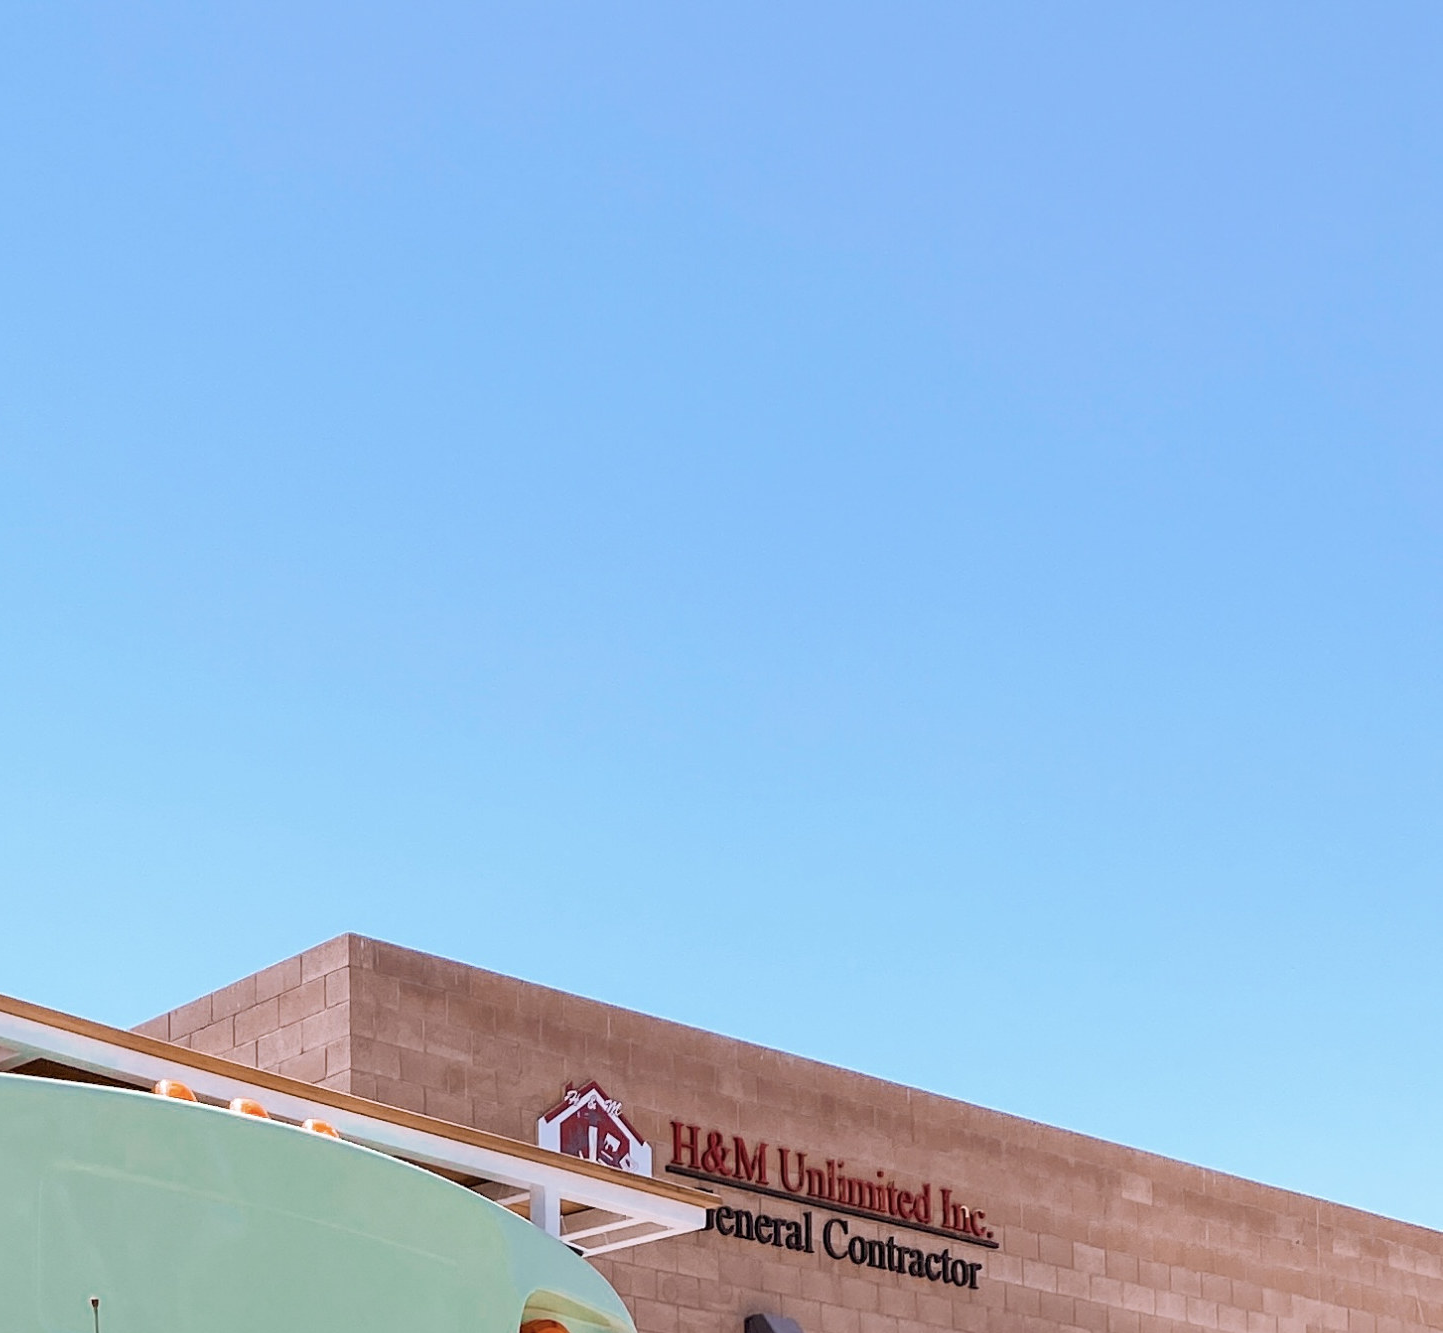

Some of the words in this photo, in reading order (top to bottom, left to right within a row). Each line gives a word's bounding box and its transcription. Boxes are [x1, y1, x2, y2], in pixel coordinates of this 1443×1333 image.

[670, 1120, 769, 1185] H&M
[777, 1147, 931, 1224] Unlimited
[940, 1188, 994, 1239] Inc.
[822, 1218, 983, 1290] Contractor
